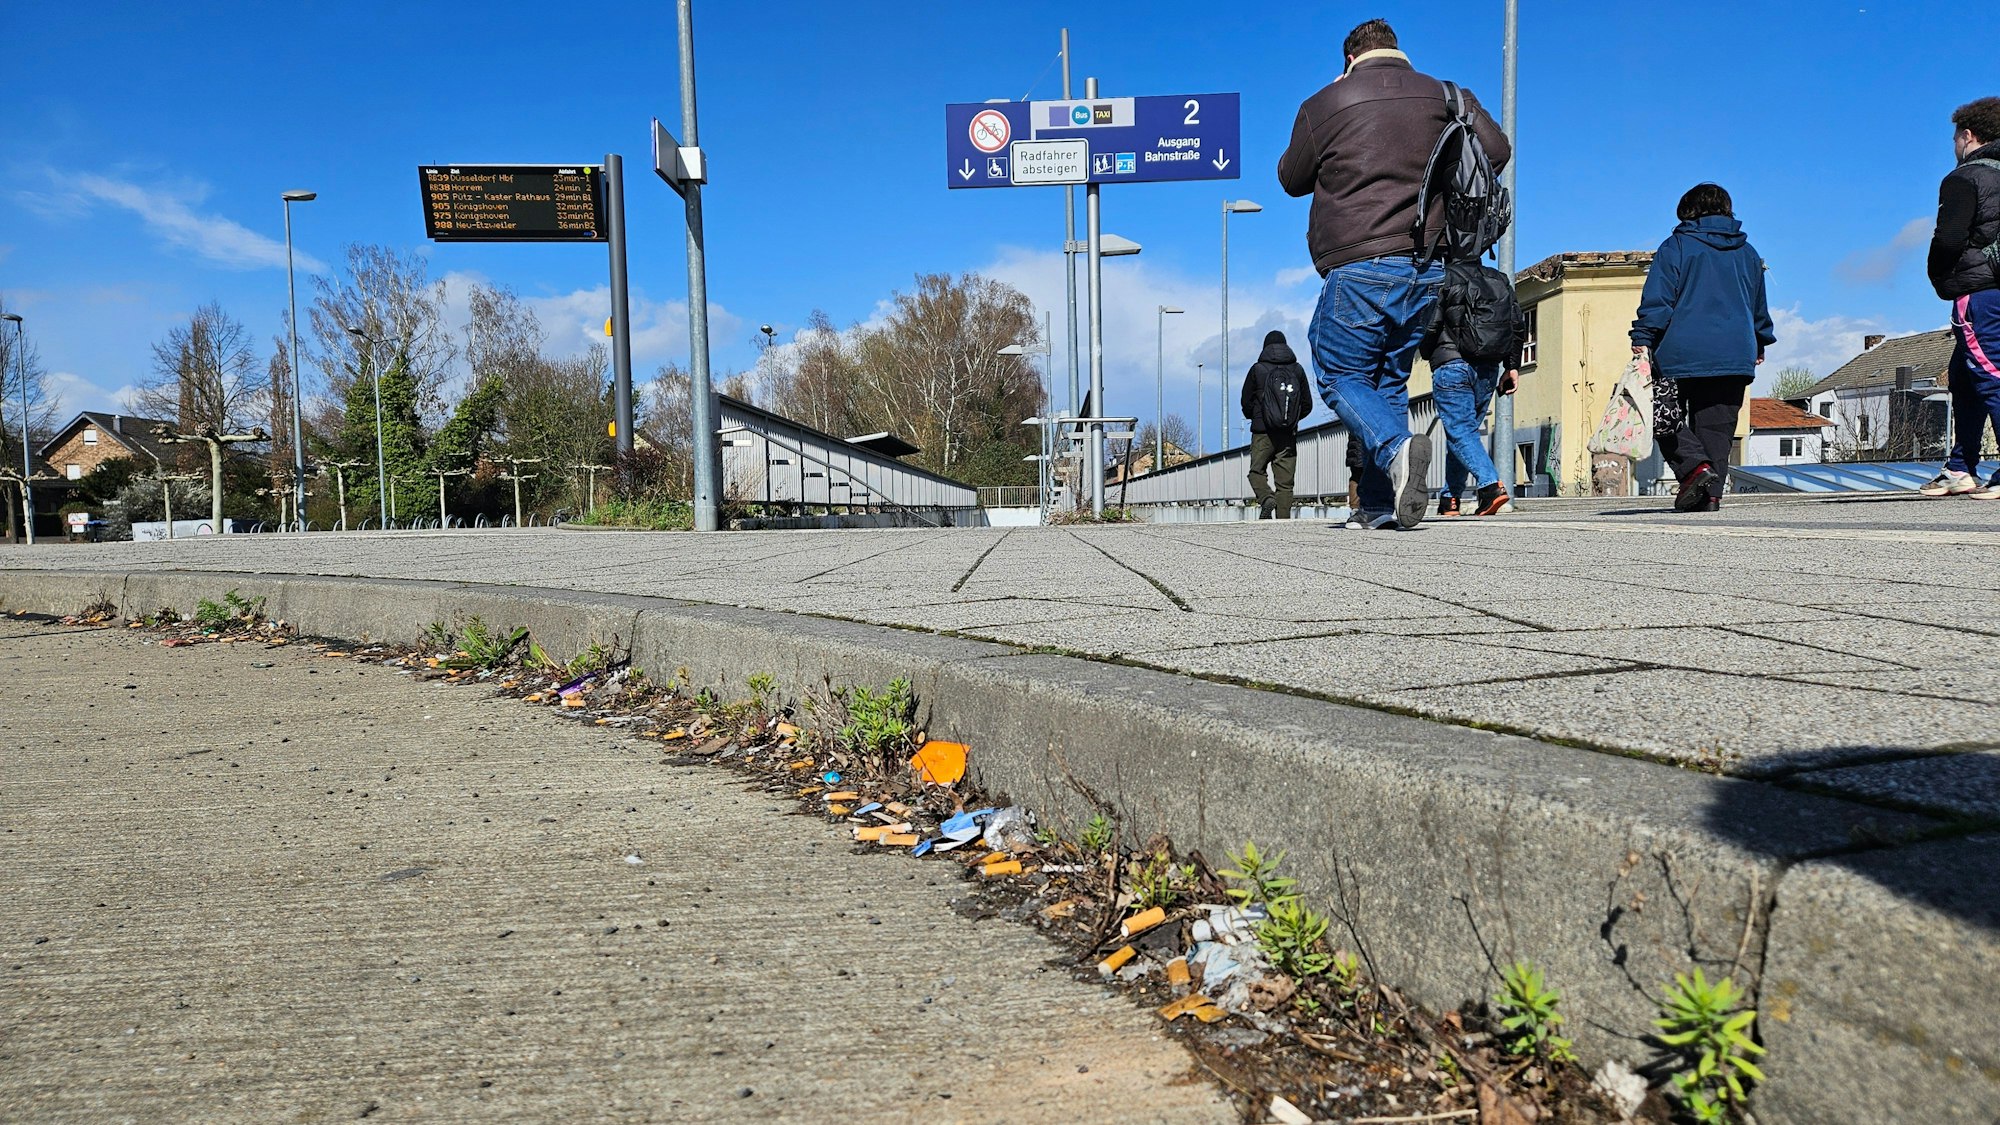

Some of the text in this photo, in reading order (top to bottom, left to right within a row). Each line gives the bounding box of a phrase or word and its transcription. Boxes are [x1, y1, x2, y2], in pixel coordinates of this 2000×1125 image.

[1075, 111, 1088, 119] Bus
[1183, 99, 1200, 125] 2
[1157, 137, 1201, 149] Ausgang
[1020, 150, 1078, 161] Radfahrer
[1145, 150, 1200, 162] Bahnstraße
[1022, 164, 1078, 176] absteigen
[450, 174, 496, 183] Düsseldorf
[499, 174, 514, 183] Hbf
[586, 184, 592, 192] 2
[430, 193, 449, 201] 905
[452, 193, 473, 201] Pütz
[484, 193, 513, 201] Kaster
[515, 193, 551, 201] Rathaus
[453, 202, 509, 212] Königshoven
[455, 212, 510, 221] Königshoven
[456, 221, 517, 229] Neu-Etzweiler
